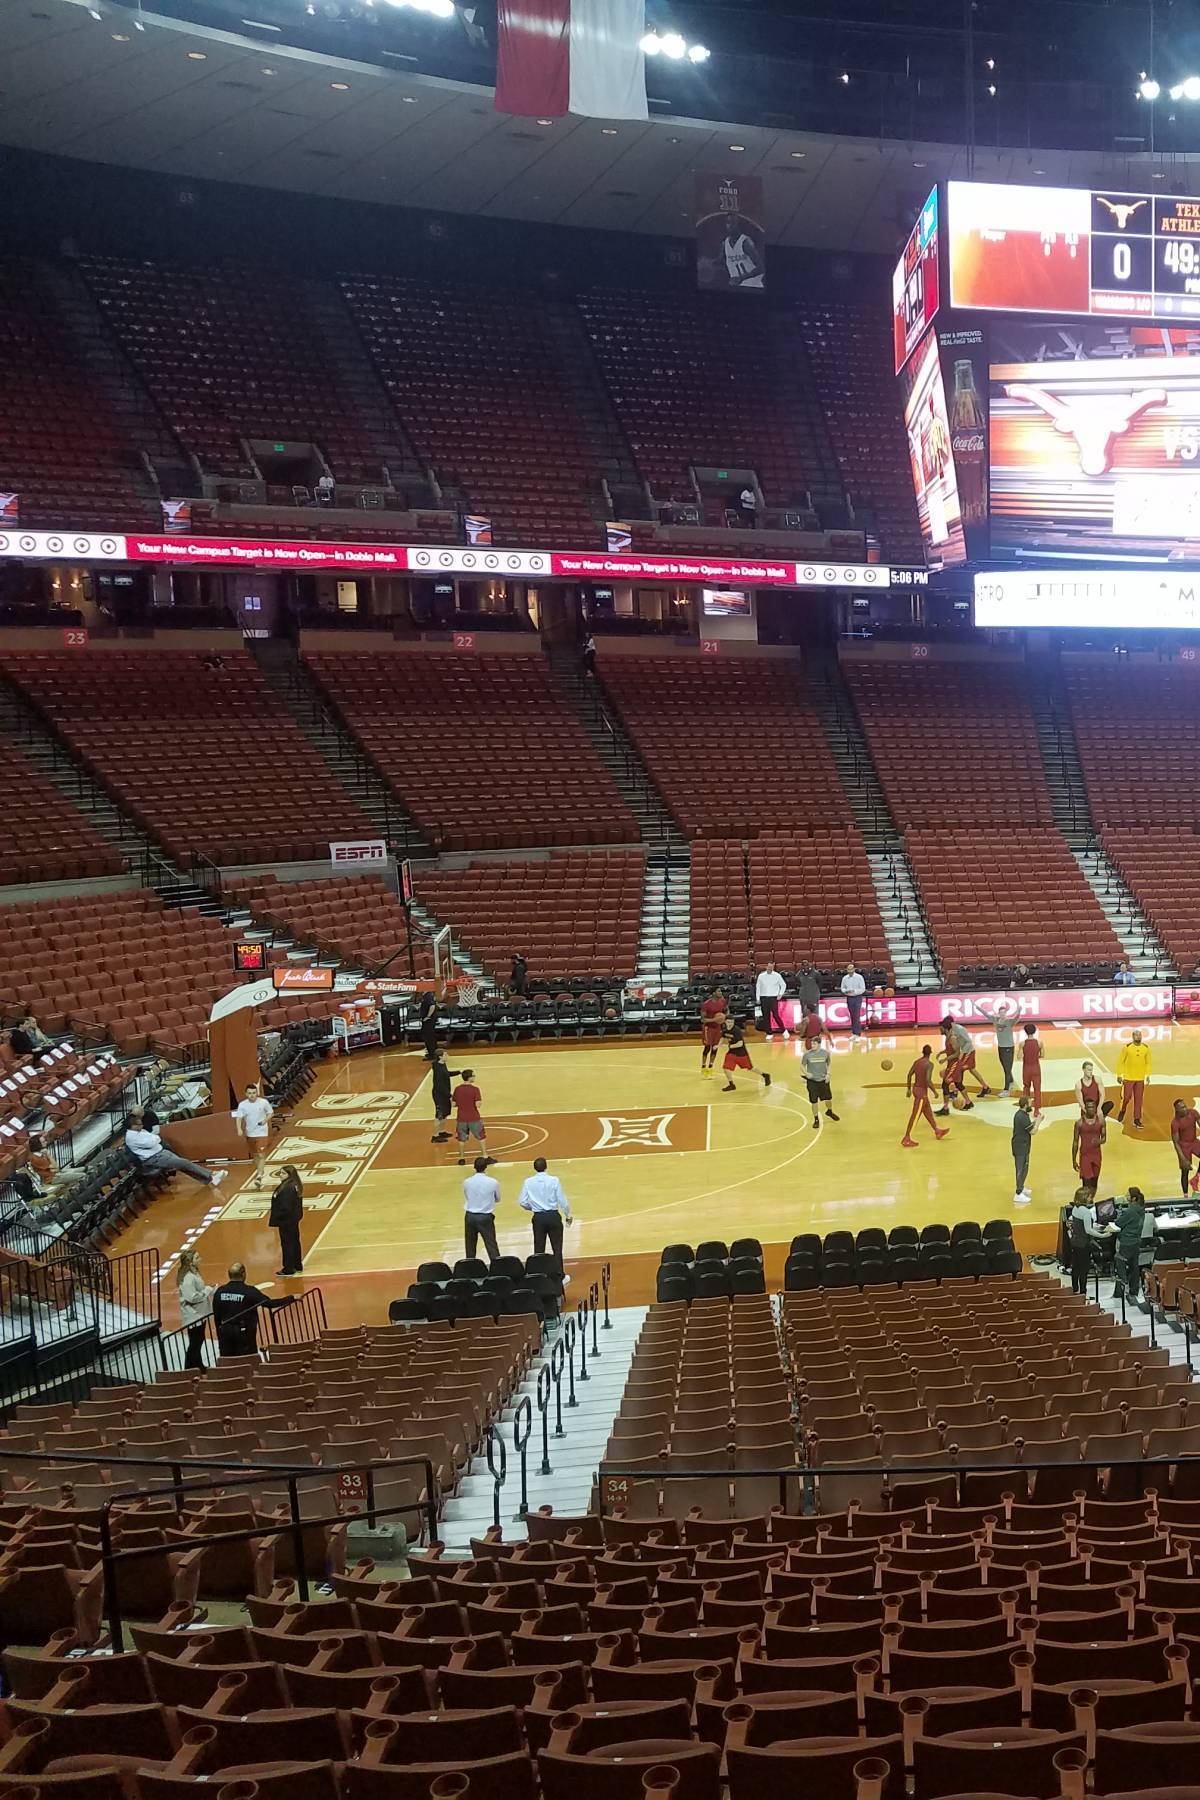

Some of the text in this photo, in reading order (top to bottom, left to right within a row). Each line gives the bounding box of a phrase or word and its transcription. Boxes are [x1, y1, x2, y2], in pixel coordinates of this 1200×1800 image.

[1113, 243, 1131, 279] 0
[1163, 427, 1199, 460] VS
[137, 543, 161, 553] Your
[163, 544, 187, 554] New
[188, 545, 231, 557] Campus
[231, 546, 263, 558] Target
[264, 548, 273, 558] is
[274, 549, 297, 558] Now
[561, 560, 581, 569] Your
[582, 560, 603, 569] New
[604, 561, 641, 572] Campus
[642, 562, 669, 573] Target
[670, 564, 678, 573] is
[679, 564, 700, 573] Now
[891, 571, 928, 584] 5:06 PM
[67, 632, 85, 644] 23
[457, 636, 473, 647] 22
[704, 641, 718, 652] 21
[913, 646, 928, 657] 20
[1181, 650, 1196, 660] 49
[335, 845, 383, 860] ESPN
[237, 945, 261, 954] 49:50
[941, 996, 1040, 1018] RICOH
[1082, 992, 1173, 1013] RICOH
[220, 1292, 245, 1302] SECURITY
[342, 1474, 361, 1487] 33
[608, 1480, 628, 1492] 34
